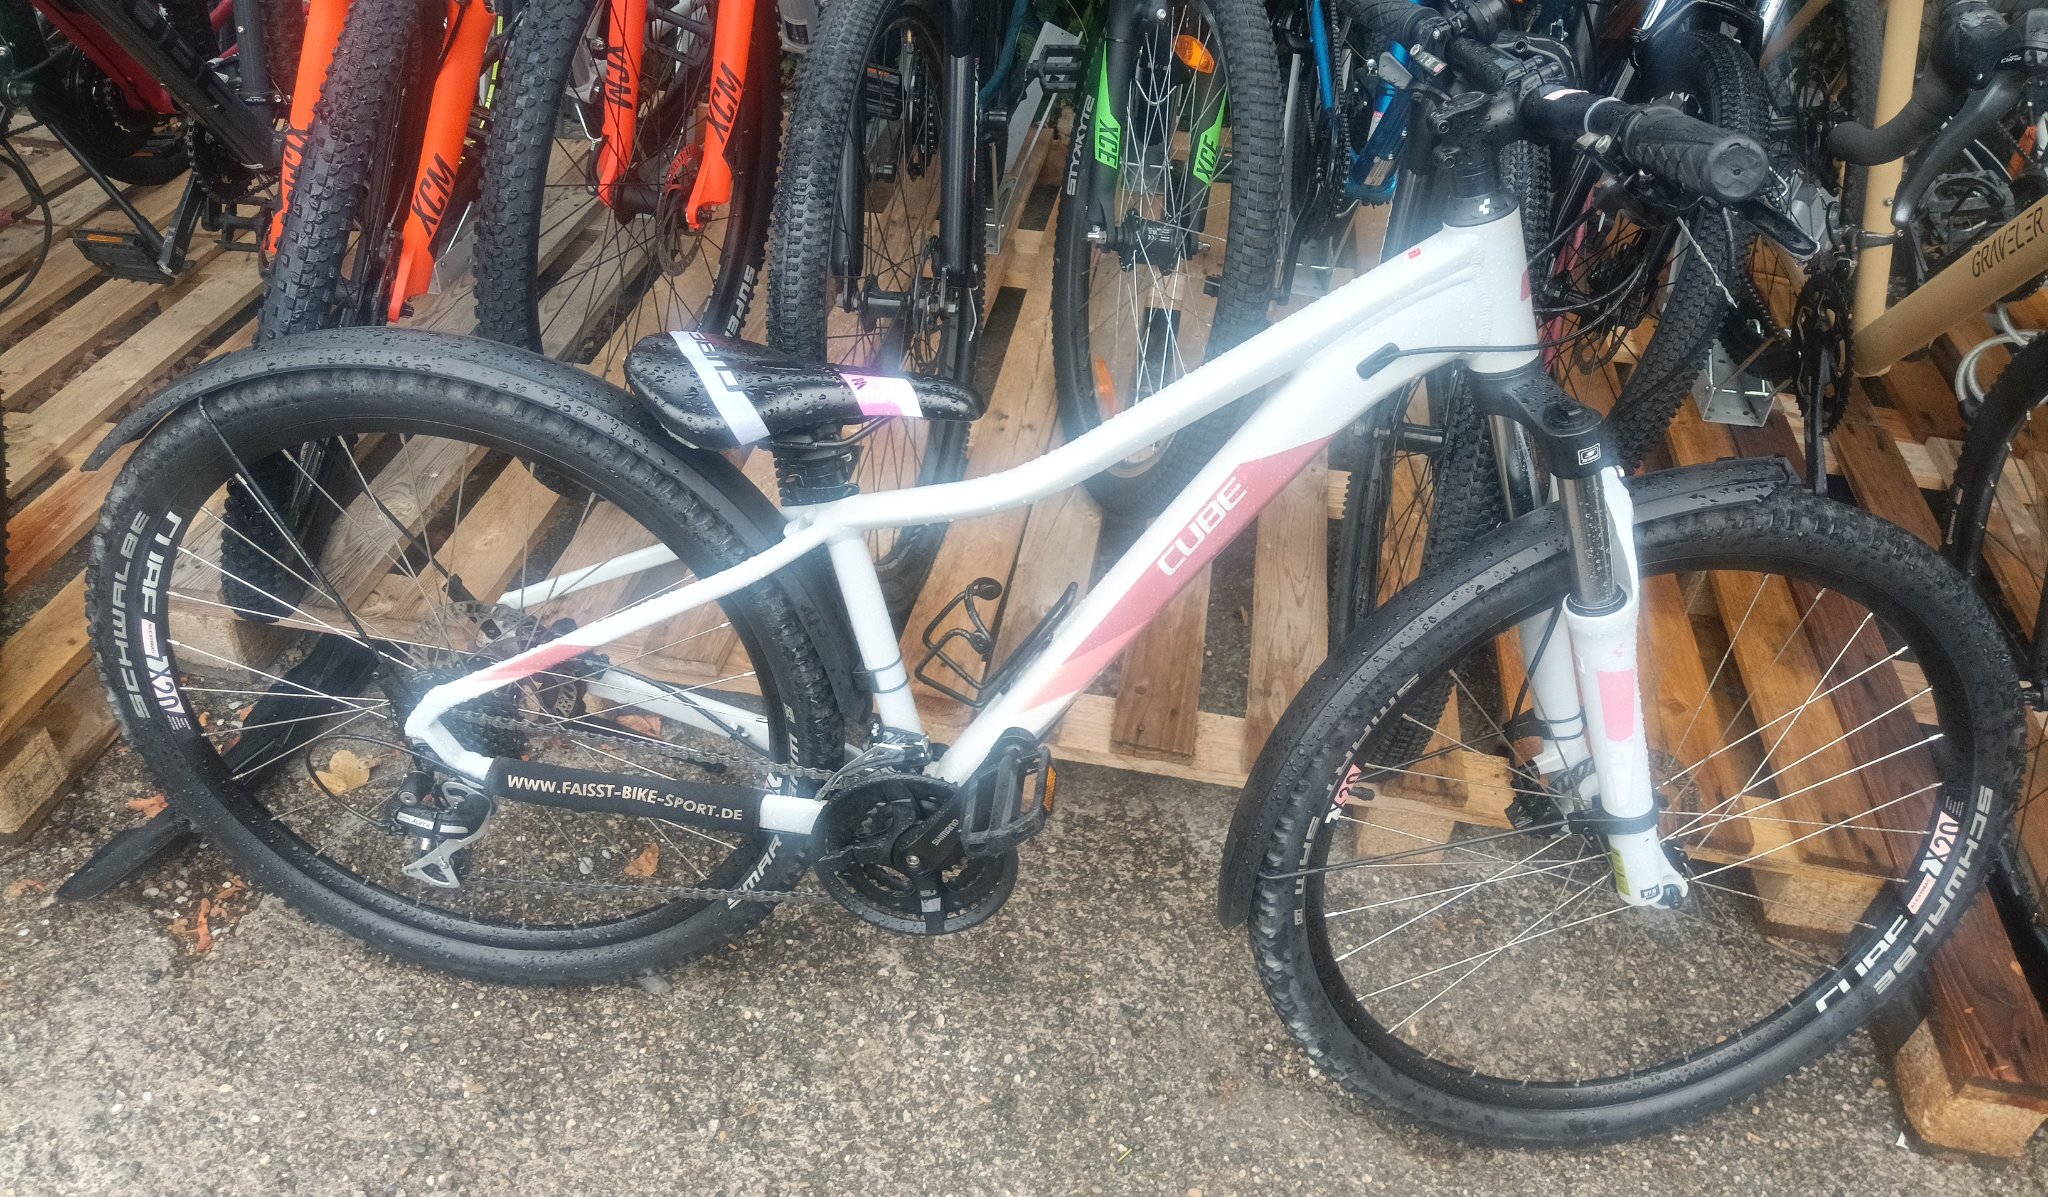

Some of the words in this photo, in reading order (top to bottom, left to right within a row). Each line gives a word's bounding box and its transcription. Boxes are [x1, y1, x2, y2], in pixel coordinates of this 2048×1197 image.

[607, 46, 633, 110] XCM
[707, 62, 743, 145] XCM
[1099, 118, 1119, 169] XCE
[1196, 135, 1218, 181] XCE
[411, 152, 457, 238] XCM
[1972, 206, 2044, 277] GRAVELER
[724, 264, 756, 338] SUPE
[1157, 475, 1248, 577] CUBE
[112, 510, 150, 719] SCHWALBE
[507, 774, 743, 821] WWW.FAISST-BIKE-SPORT.DE
[931, 818, 960, 847] SHIMANO
[1873, 785, 1994, 996] SCHWALBE
